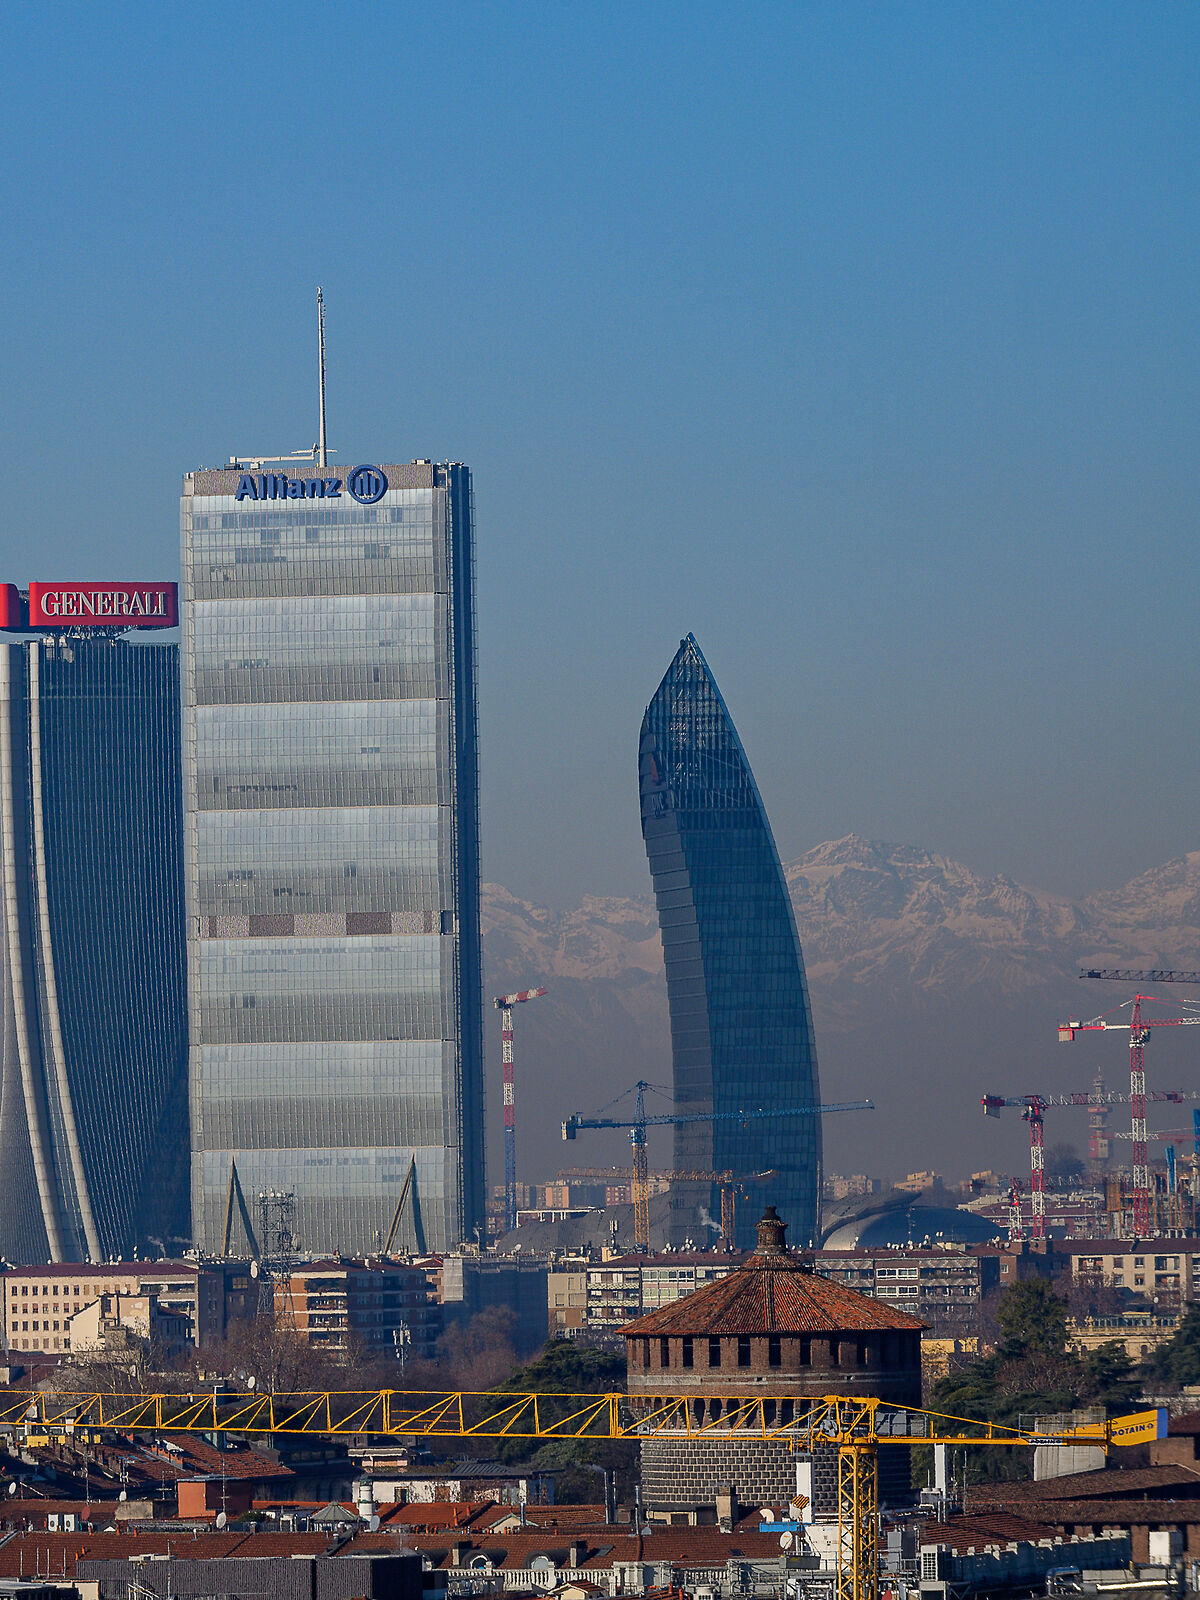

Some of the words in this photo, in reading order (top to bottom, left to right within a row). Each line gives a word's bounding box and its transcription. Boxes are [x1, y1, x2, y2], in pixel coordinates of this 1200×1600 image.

[235, 473, 341, 501] Allianz
[40, 591, 166, 616] GENERALI
[1112, 1426, 1145, 1437] POTAIN
